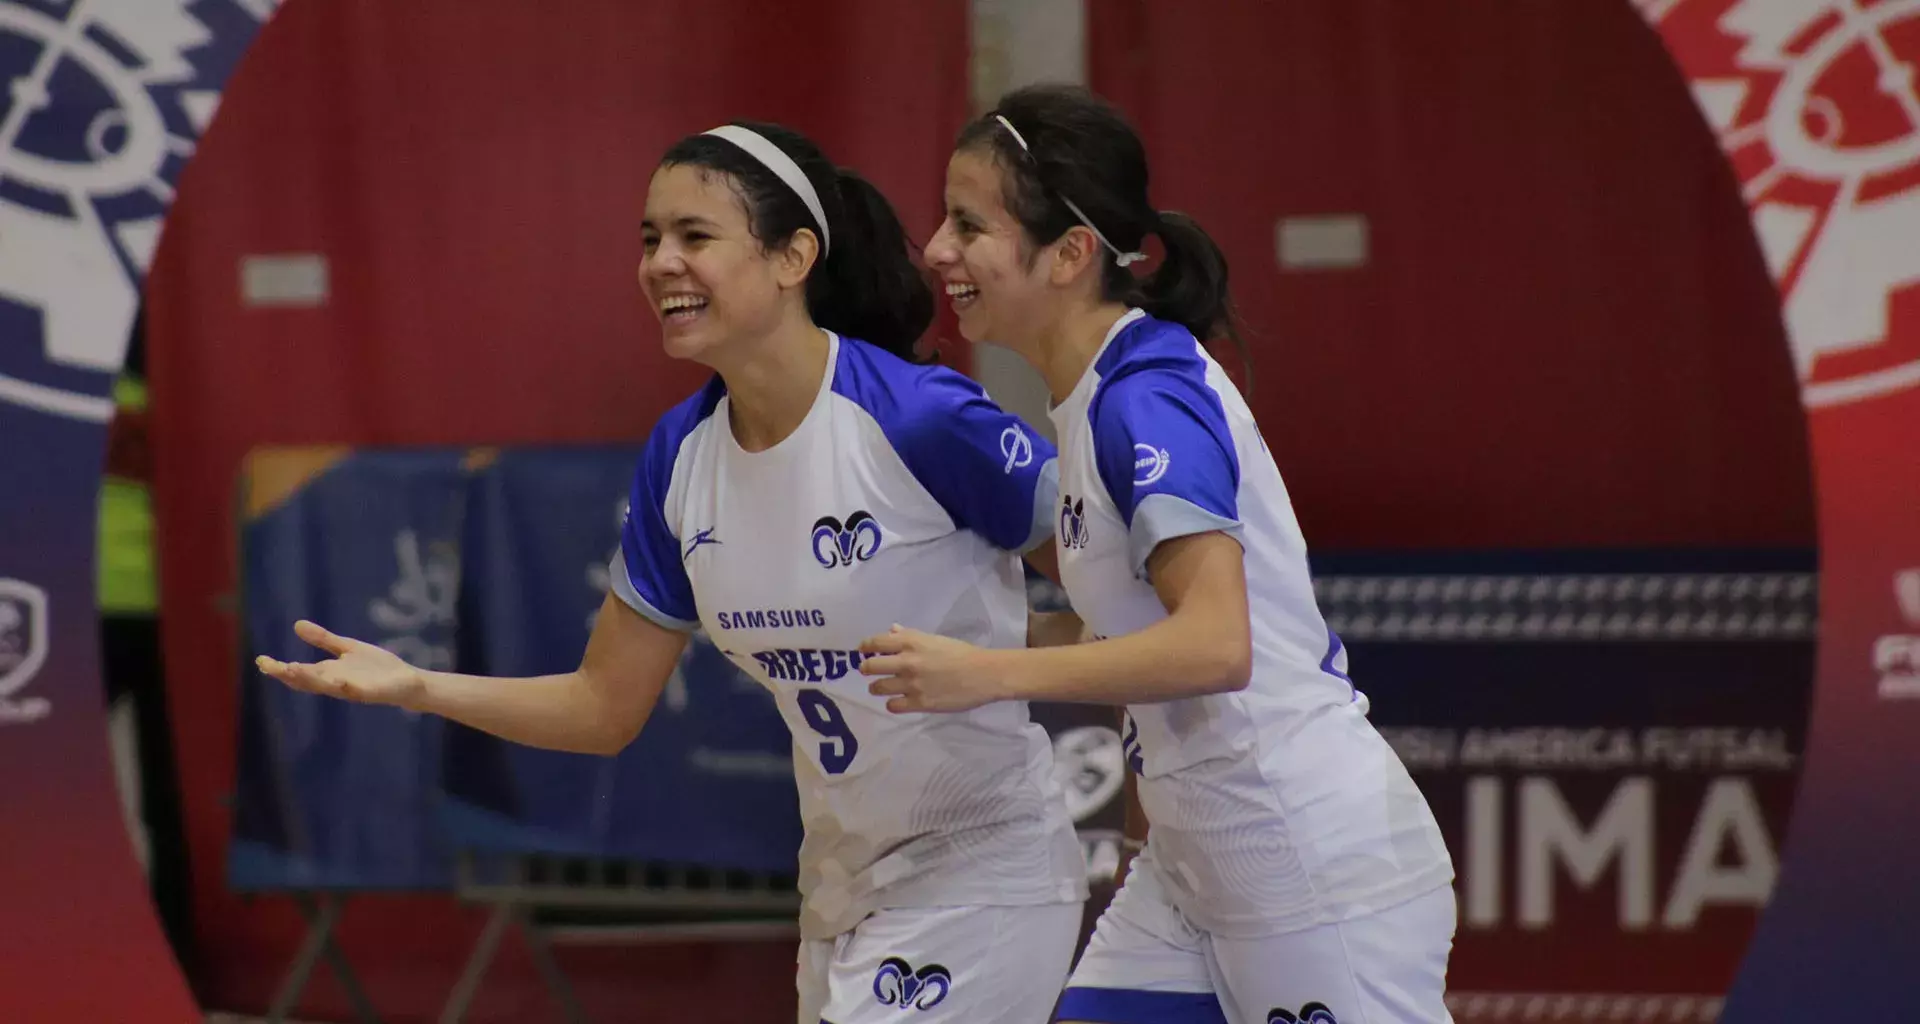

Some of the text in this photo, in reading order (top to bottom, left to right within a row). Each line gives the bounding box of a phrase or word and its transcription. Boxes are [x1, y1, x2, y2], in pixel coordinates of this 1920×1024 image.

[717, 608, 826, 630] SAMSUNG
[796, 688, 859, 775] 9
[1459, 730, 1635, 769] AMERICA
[1641, 730, 1794, 770] FUTSAL
[1465, 776, 1781, 931] IMA
